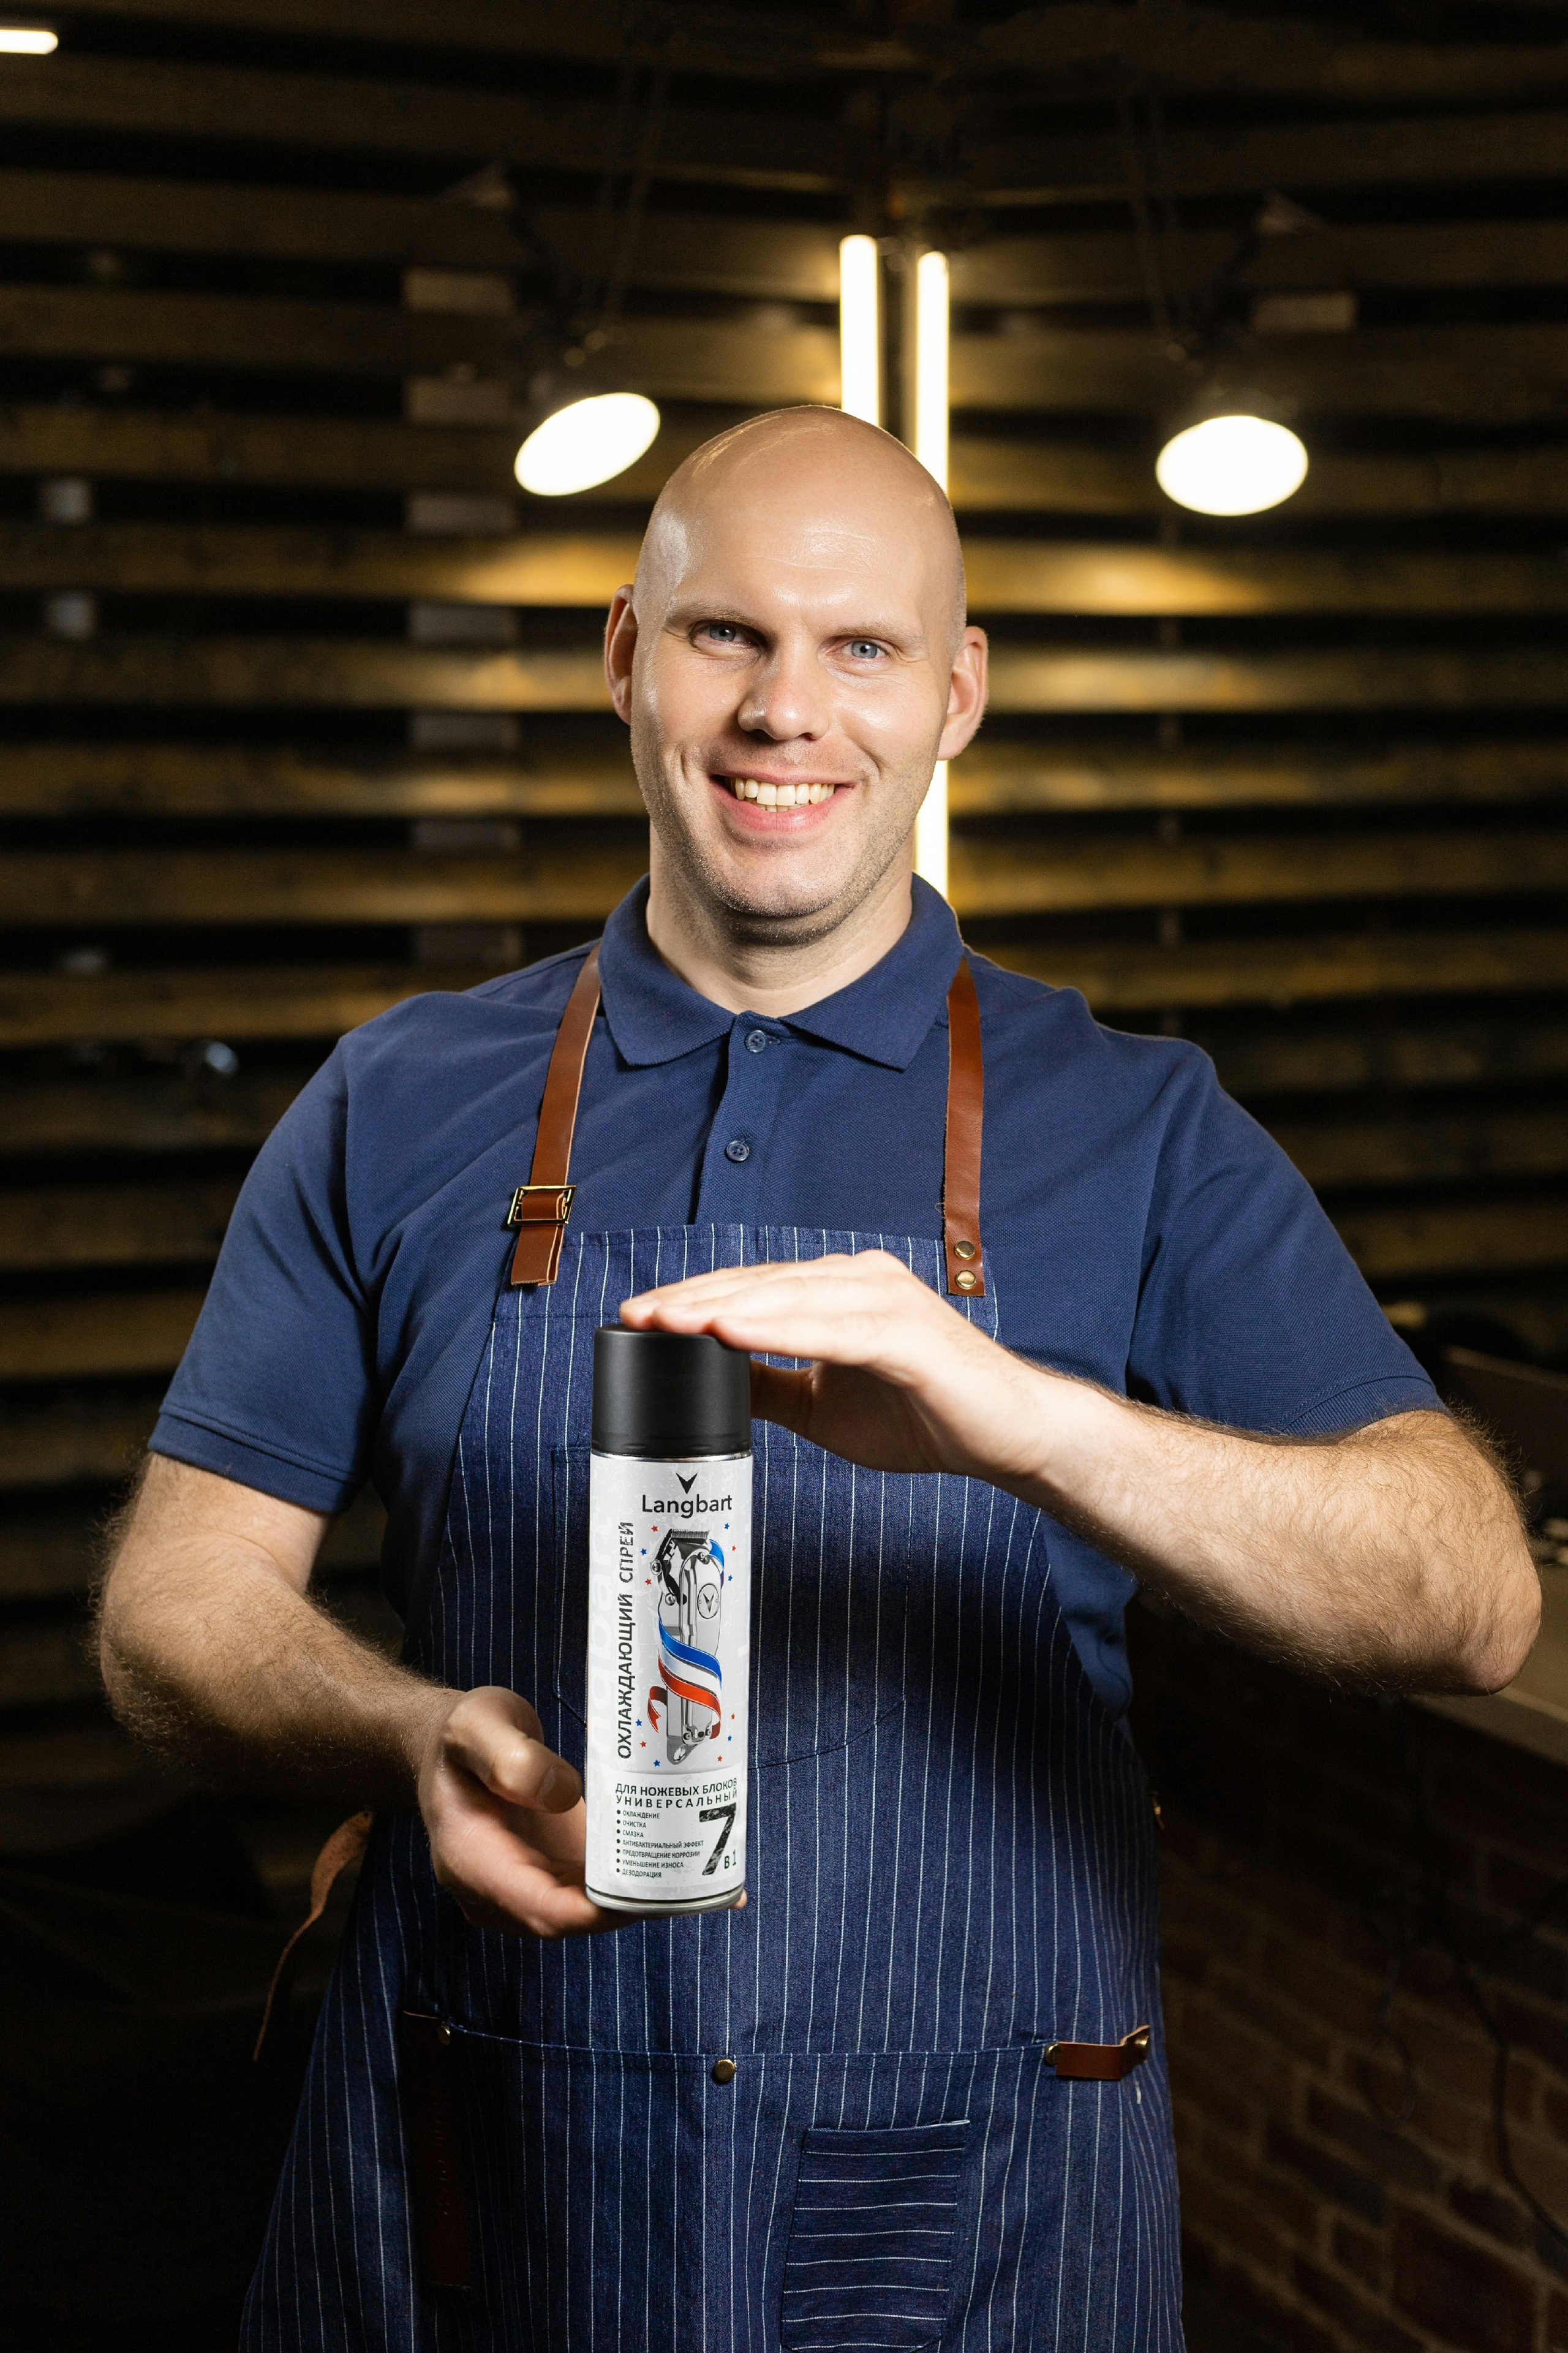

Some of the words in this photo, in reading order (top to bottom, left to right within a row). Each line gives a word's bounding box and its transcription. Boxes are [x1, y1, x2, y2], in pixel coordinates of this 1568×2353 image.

[642, 1494, 733, 1519] Langbart
[618, 1522, 634, 1584] СПРЕЙ
[617, 1593, 636, 1759] ОХЛАЖДАЮЩИЙ
[616, 1783, 636, 1794] ДЛЯ
[640, 1786, 699, 1796] НОЖЕВЫХ
[703, 1778, 737, 1794] БЛОКОВ
[617, 1788, 737, 1808] УНИВЕРСАЛЬНЫЙ
[622, 1810, 660, 1819] ОХЛАЖДЕНИЕ
[622, 1840, 682, 1849] АНТИБАКТЕРИАЛЬНЫЙ
[699, 1802, 736, 1875] 7
[733, 1849, 737, 1866] 1
[622, 1849, 671, 1859] ПРЕДОТВРАЩЕНИЕ
[622, 1859, 660, 1868] УМЕНЬШЕНИЕ
[622, 1869, 662, 1878] ДЕЗОДОРАЦИЯ
